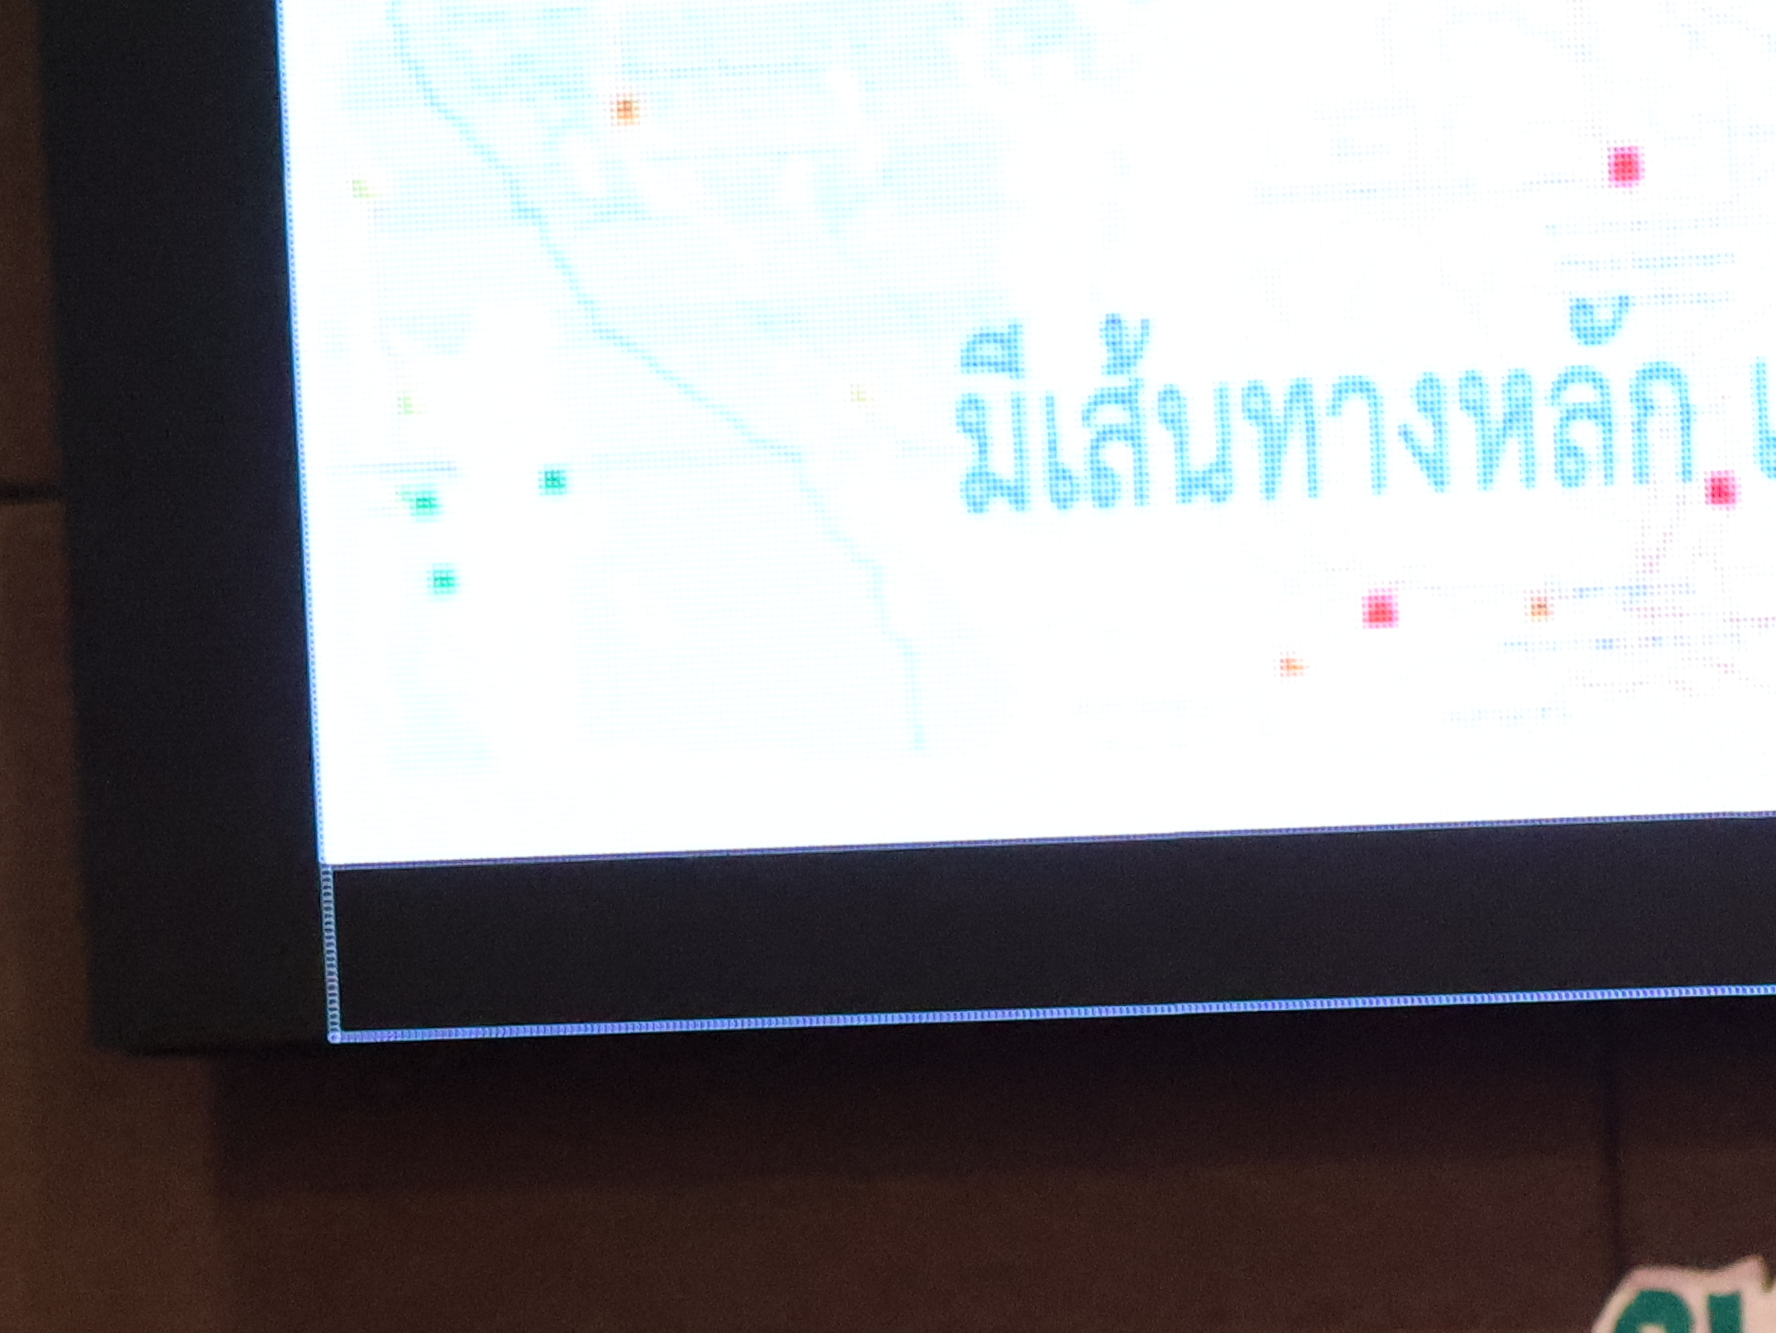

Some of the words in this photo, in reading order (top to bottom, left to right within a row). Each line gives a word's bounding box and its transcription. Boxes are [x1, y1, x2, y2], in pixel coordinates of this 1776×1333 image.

[954, 291, 1697, 514] มีเส้นทางหลัก
